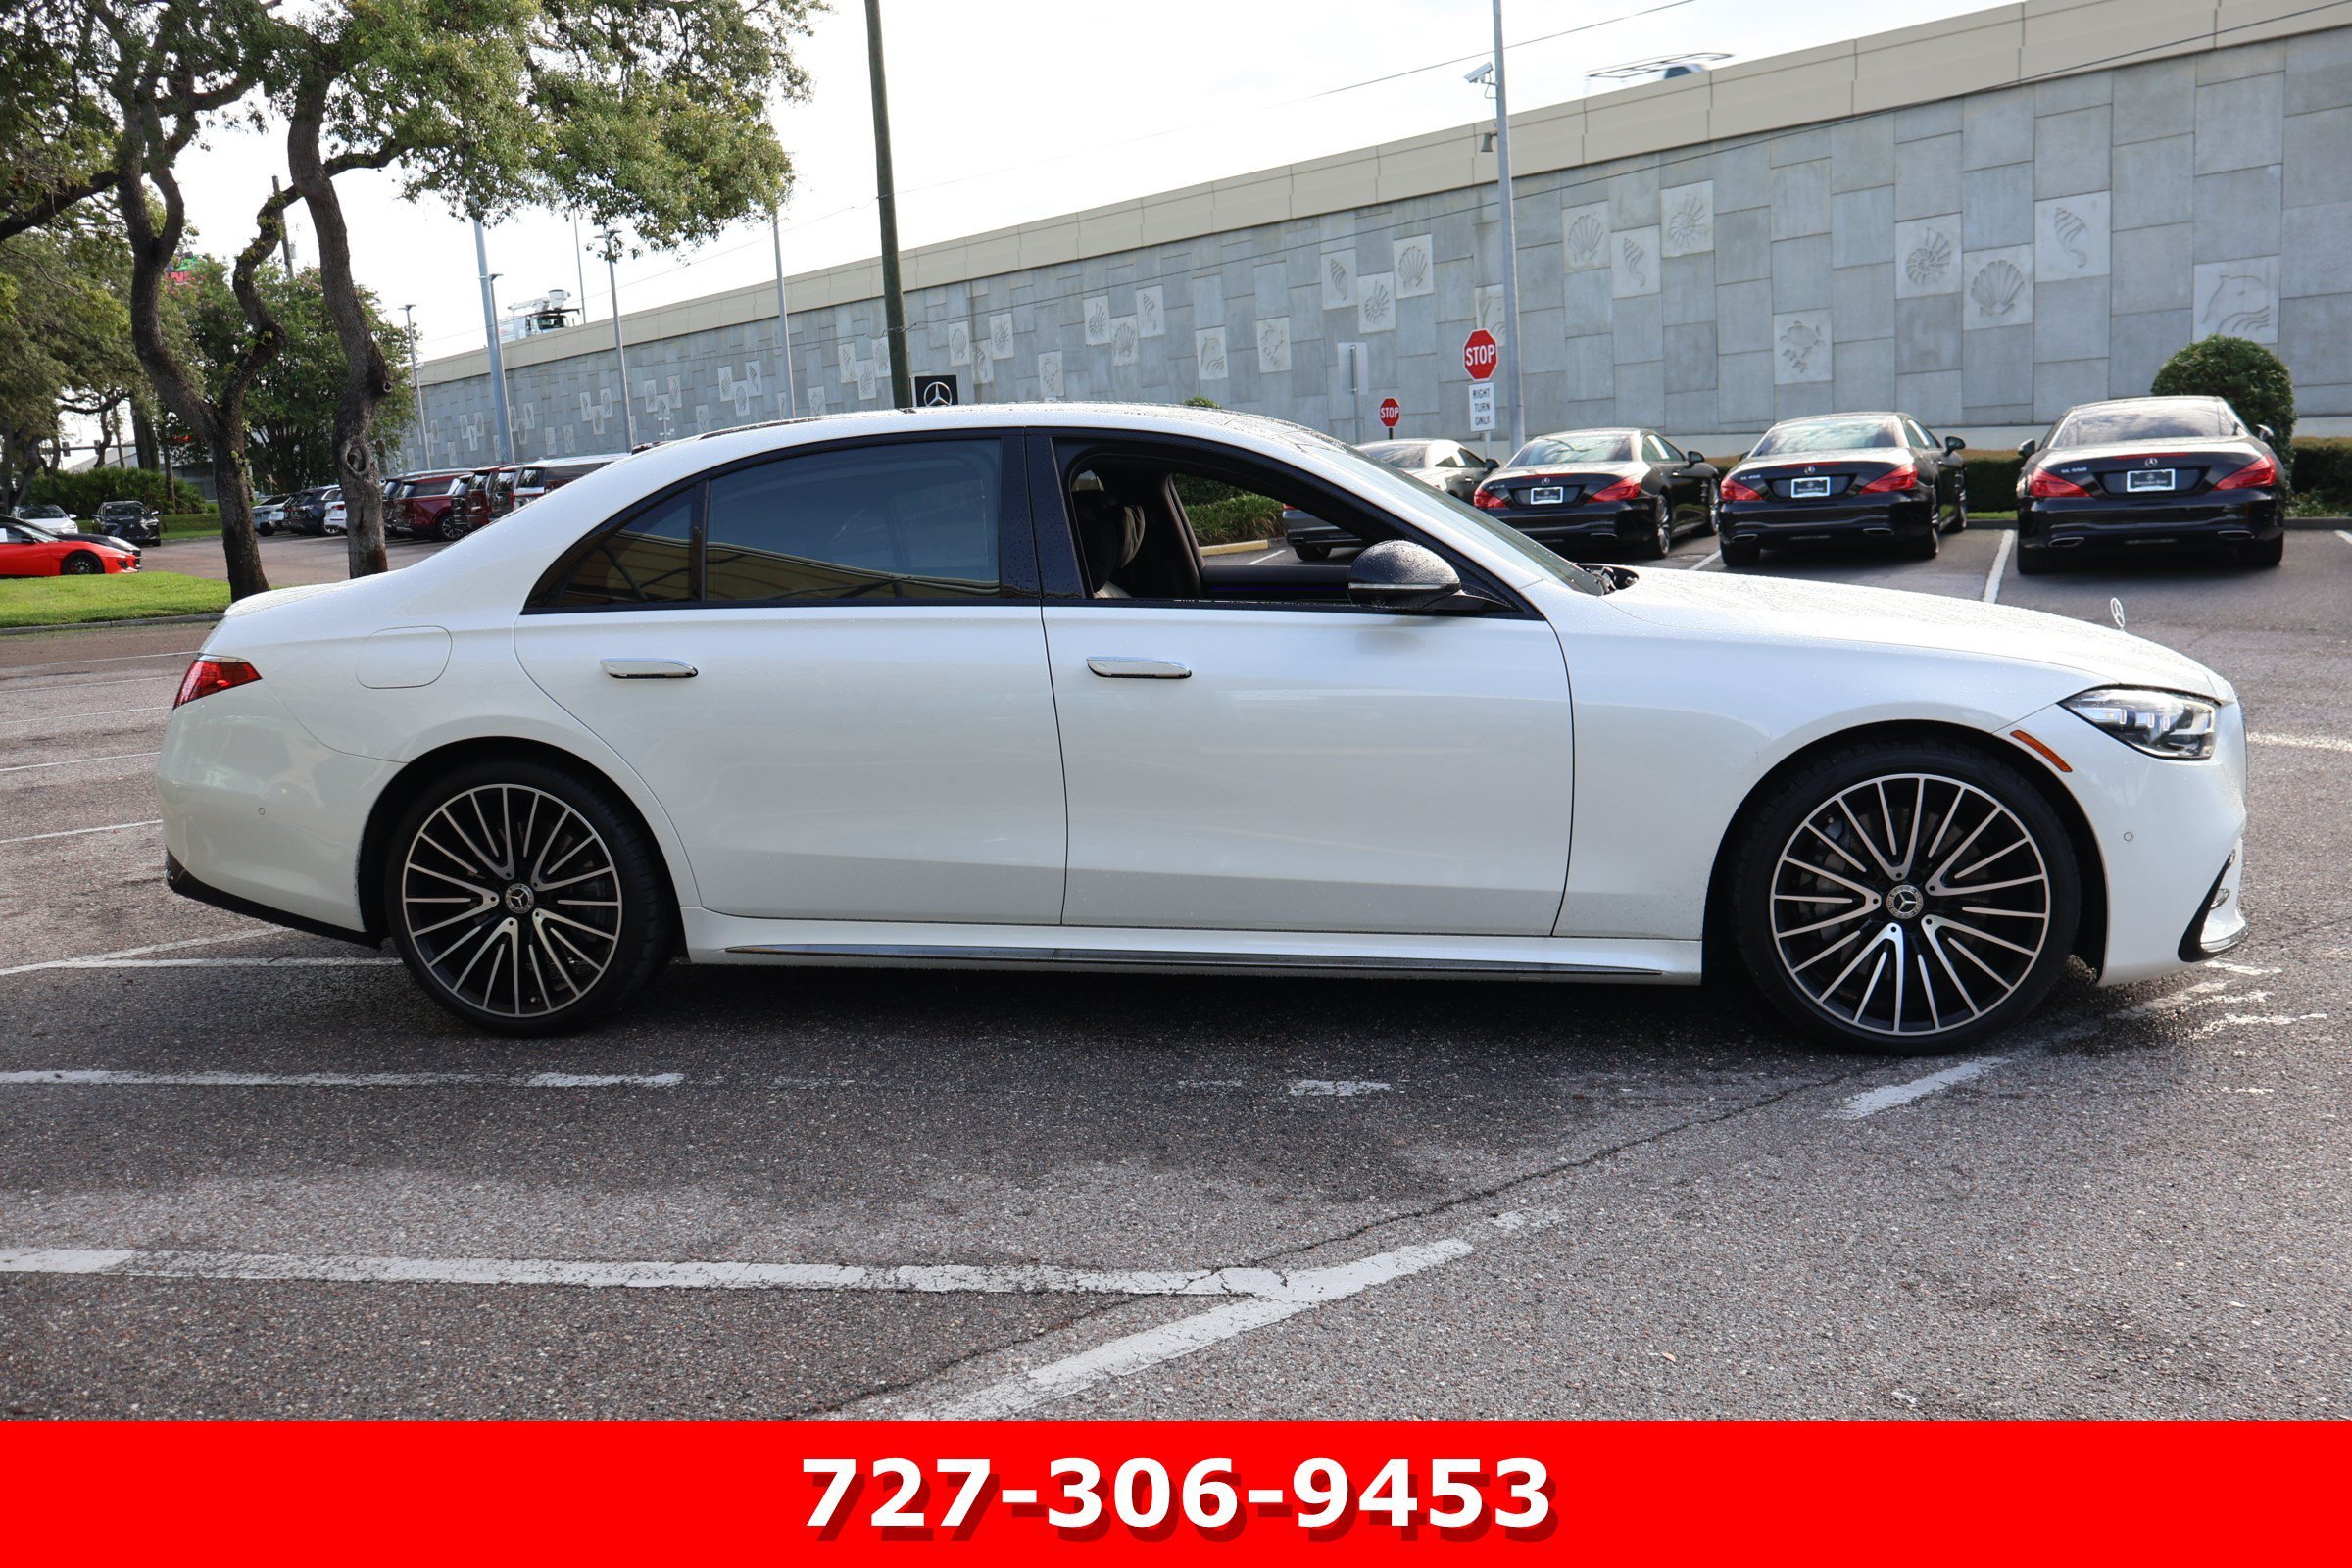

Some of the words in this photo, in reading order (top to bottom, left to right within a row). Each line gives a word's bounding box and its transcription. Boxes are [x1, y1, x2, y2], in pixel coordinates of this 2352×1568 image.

[1465, 344, 1495, 367] STOP
[1473, 387, 1490, 399] RIGHT
[1380, 407, 1399, 418] STOP
[1474, 402, 1490, 413] TURN
[1475, 416, 1490, 426] ONLY
